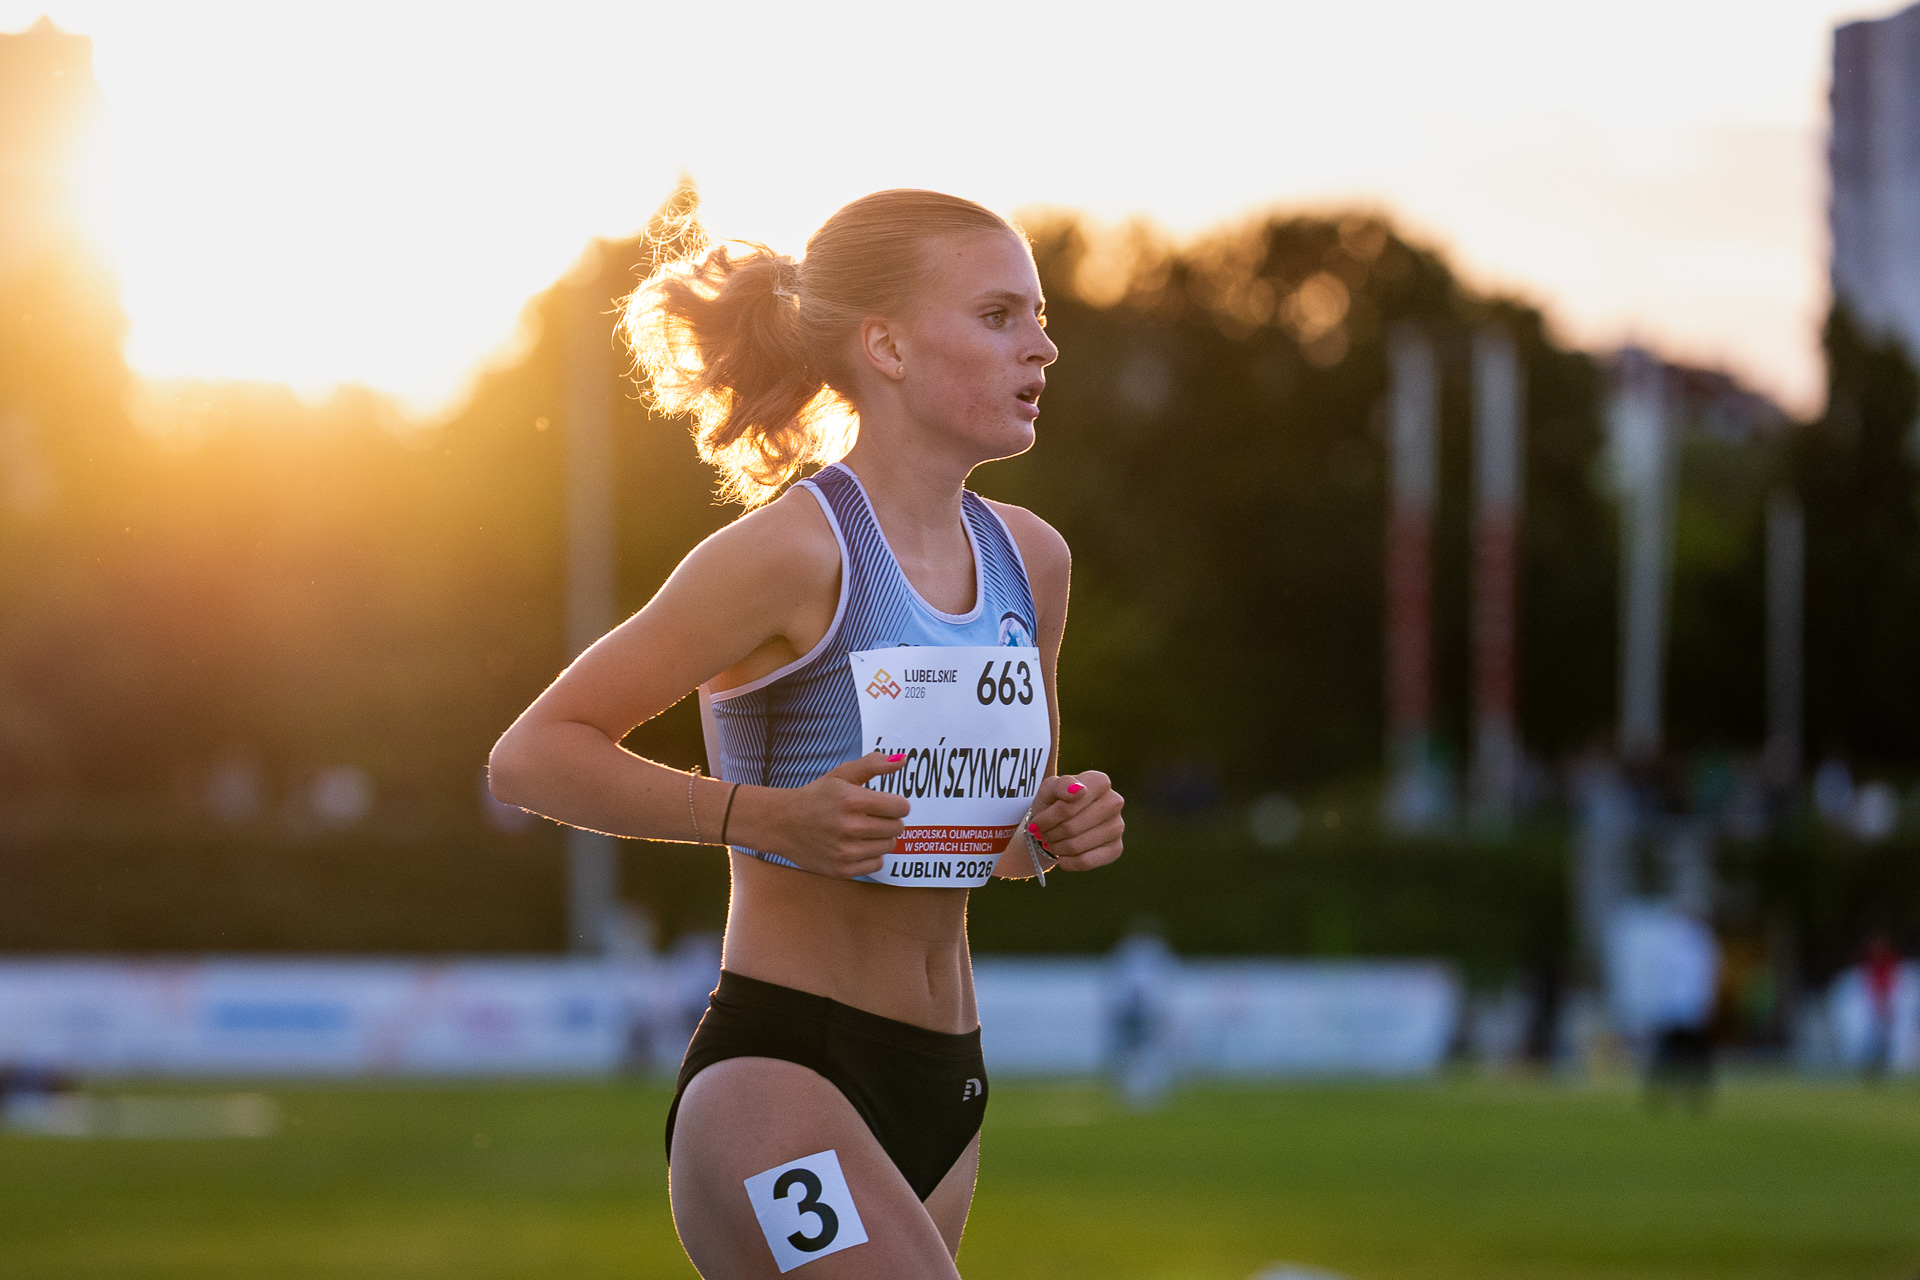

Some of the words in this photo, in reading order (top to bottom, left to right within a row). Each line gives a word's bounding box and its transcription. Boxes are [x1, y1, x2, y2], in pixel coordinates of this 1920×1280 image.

[904, 669, 957, 683] LUBELSKIE
[977, 660, 1034, 706] 663
[904, 686, 926, 699] 2026
[948, 829, 993, 839] OLIMPIADA
[904, 842, 914, 851] W
[914, 841, 958, 852] SPORTACH
[959, 842, 993, 852] LETNICH
[890, 861, 952, 878] LUBLIN
[955, 861, 993, 878] 2026
[773, 1168, 839, 1252] 3
